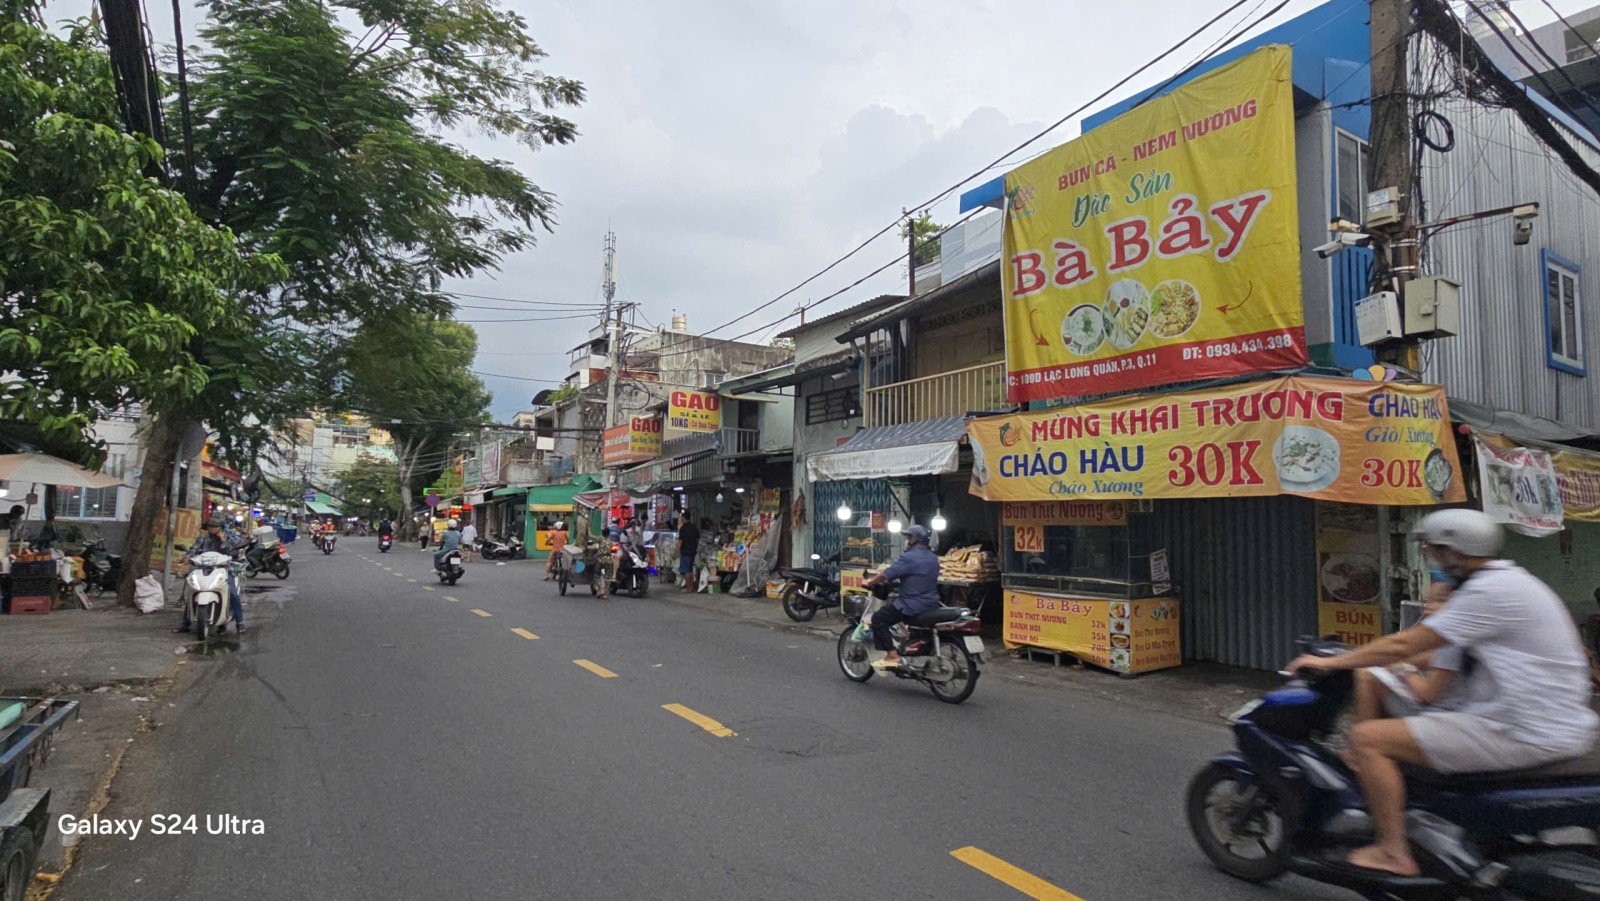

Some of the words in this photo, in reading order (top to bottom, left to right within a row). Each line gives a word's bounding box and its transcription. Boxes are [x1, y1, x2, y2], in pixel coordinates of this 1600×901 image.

[1133, 130, 1177, 161] NEM
[1182, 98, 1257, 143] NƯỚNG
[1125, 168, 1173, 205] Sản
[1011, 241, 1094, 296] Bà
[1107, 194, 1266, 271] Bảy
[1182, 347, 1202, 360] ĐT:
[1206, 333, 1293, 358] 0934.434.398
[1020, 372, 1041, 385] 109D
[1044, 370, 1062, 383] LẠC
[1064, 365, 1090, 379] LONG
[1031, 413, 1100, 443] MỪNG
[1110, 403, 1179, 436] KHAI
[999, 446, 1068, 478] CHÁO
[1079, 441, 1144, 474] HÀU
[1168, 440, 1264, 487] 30K
[1360, 458, 1423, 488] 30K
[1049, 480, 1087, 495] Cháo
[1090, 479, 1144, 496] Xương
[1336, 608, 1374, 626] BÚN
